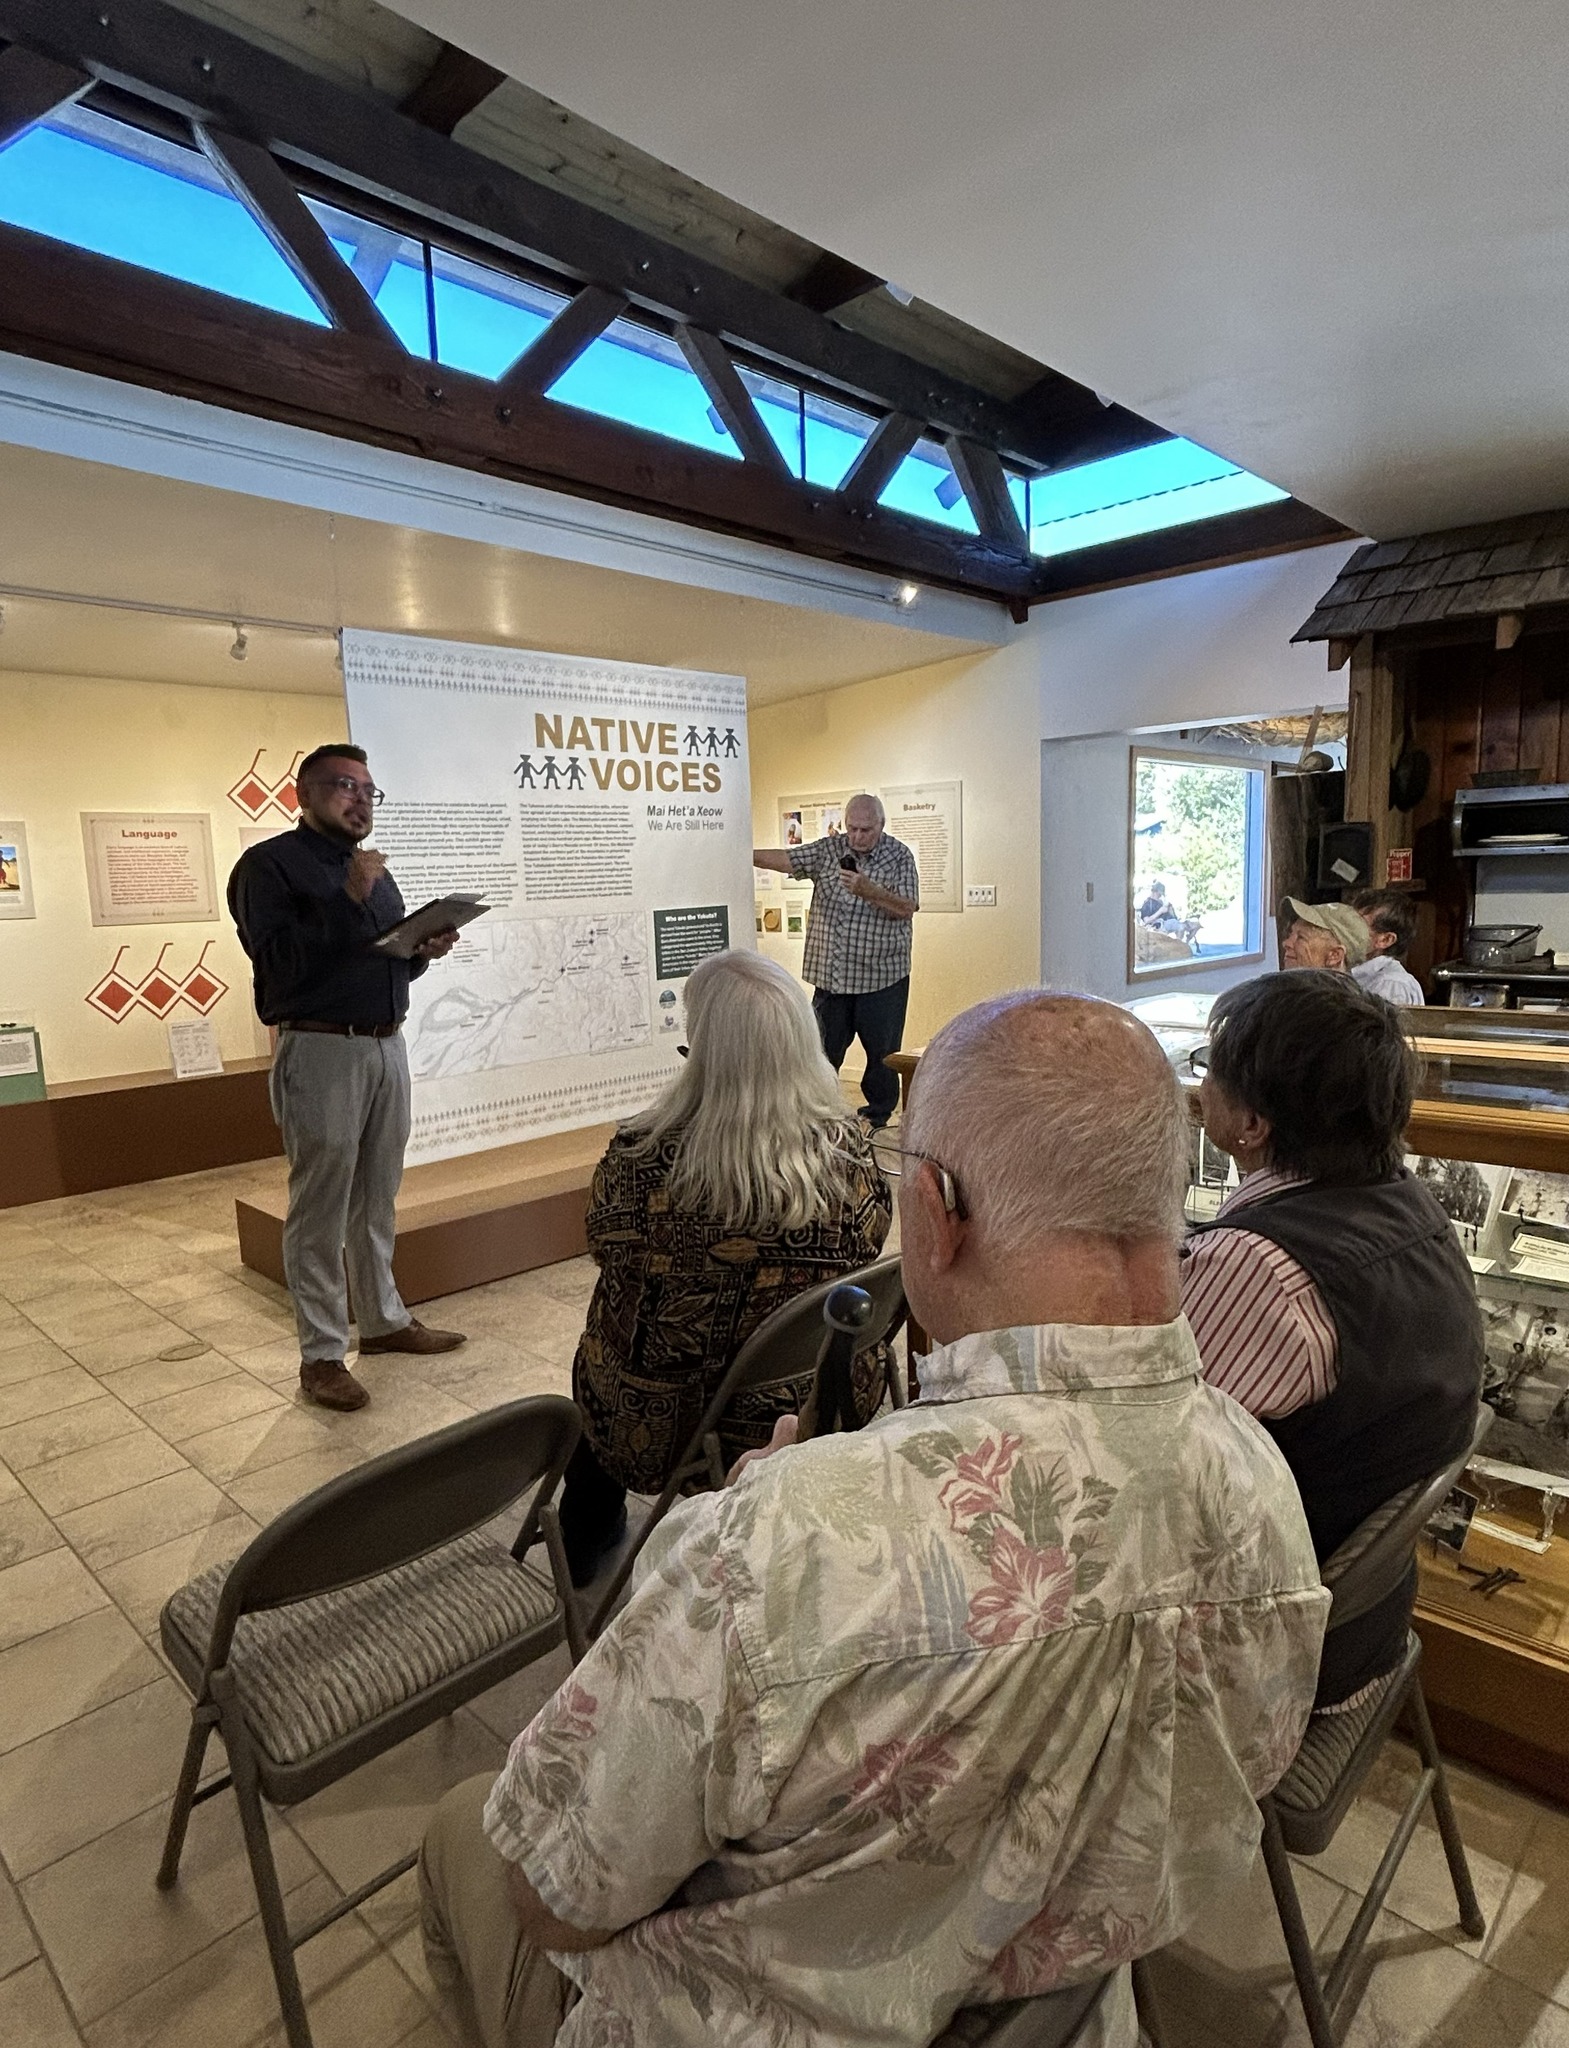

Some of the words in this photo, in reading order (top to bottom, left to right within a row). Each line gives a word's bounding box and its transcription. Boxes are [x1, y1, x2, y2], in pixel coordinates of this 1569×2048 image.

[535, 712, 679, 756] NATIVE
[589, 757, 722, 793] VOICES
[647, 805, 666, 816] Mai
[668, 805, 695, 816] Het'a
[697, 806, 723, 817] Xeow
[903, 802, 936, 812] Basketry
[647, 820, 663, 831] We
[665, 820, 682, 830] Are
[685, 820, 700, 830] Still
[702, 820, 724, 830] Here
[121, 829, 178, 840] Language
